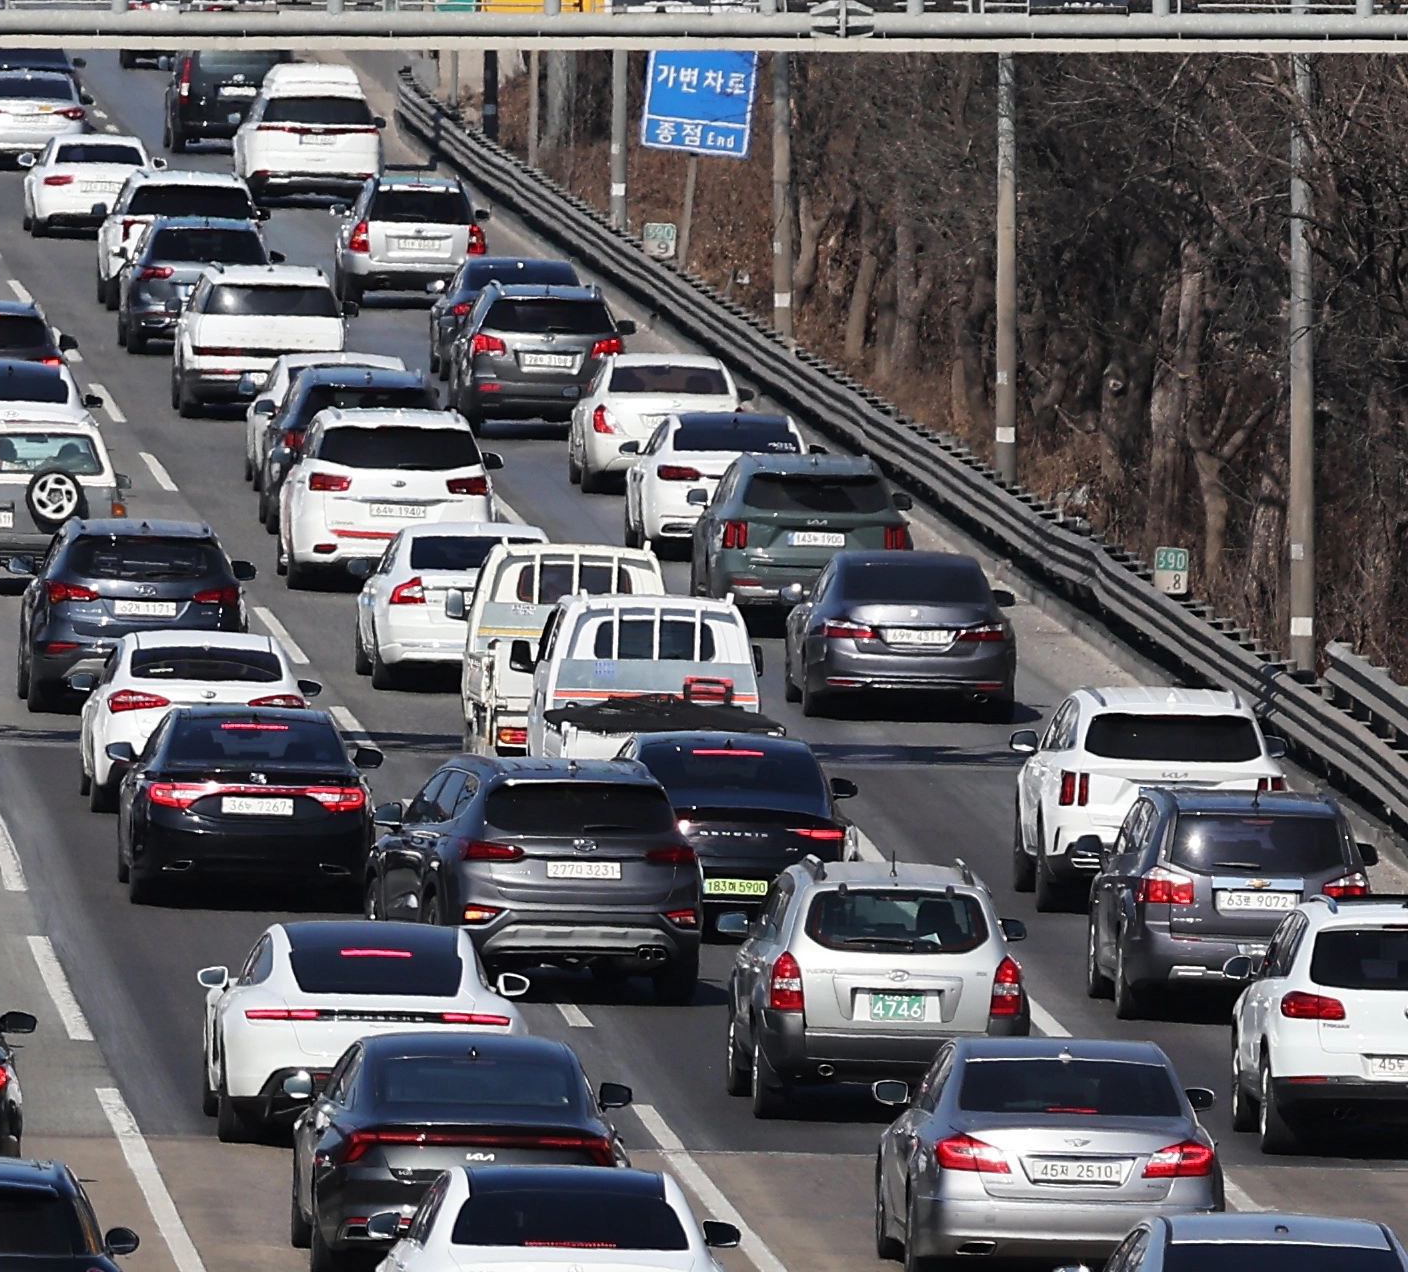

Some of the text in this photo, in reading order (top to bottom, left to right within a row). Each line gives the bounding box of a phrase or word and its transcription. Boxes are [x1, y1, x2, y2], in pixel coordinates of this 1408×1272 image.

[657, 64, 746, 95] 가변차로
[655, 121, 735, 148] 종점 End
[1157, 550, 1186, 570] 390
[258, 800, 287, 812] 7267
[586, 864, 616, 877] 3231
[739, 881, 766, 895] 5900
[1256, 894, 1288, 908] 9072
[873, 1001, 921, 1019] 4746
[1076, 1164, 1112, 1179] 2510
